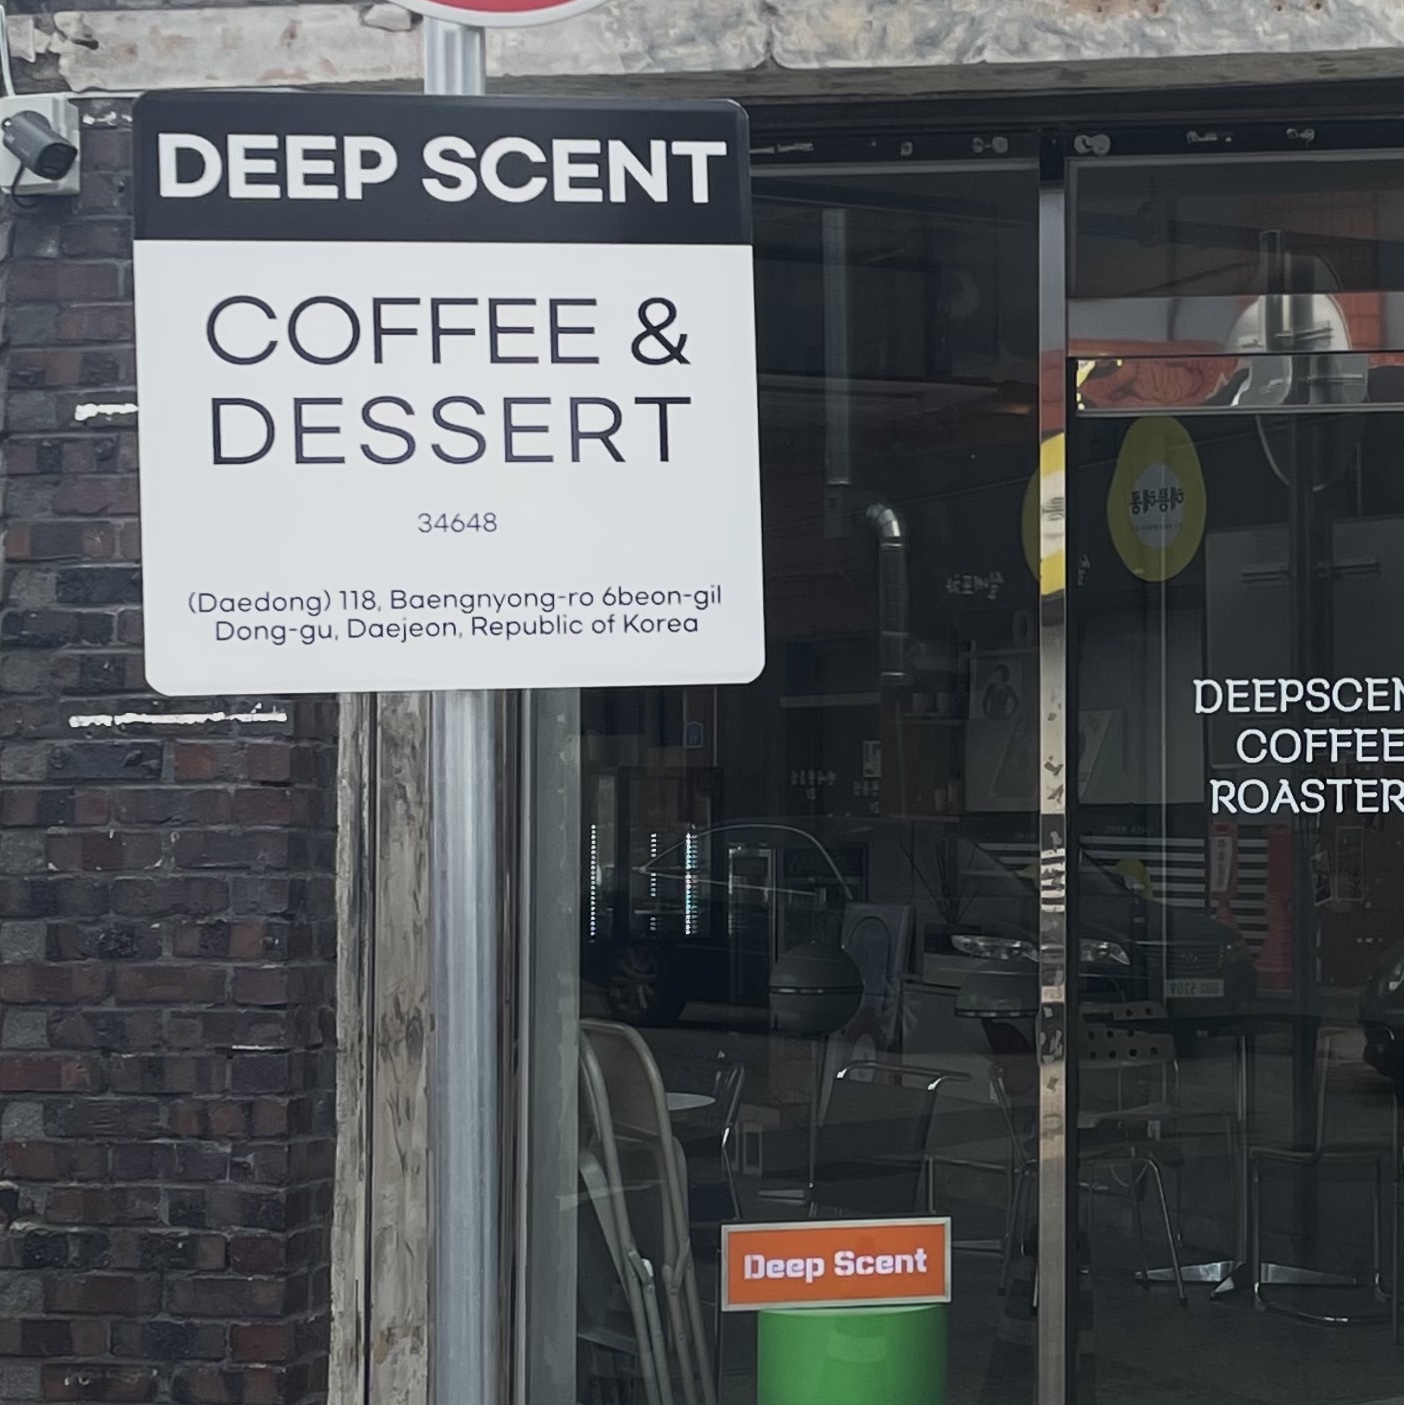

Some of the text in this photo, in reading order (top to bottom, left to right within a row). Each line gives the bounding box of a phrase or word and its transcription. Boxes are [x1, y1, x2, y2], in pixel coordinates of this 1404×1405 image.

[157, 132, 728, 204] DEEP SCENT
[205, 295, 692, 366] COFFEE &
[211, 395, 692, 467] DESSERT
[417, 511, 499, 535] 34648
[188, 584, 722, 617] (Daedong) 118, Baengnyong-ro 6beon-gil
[215, 613, 699, 646] Dong-gu, Daejeon, Republic of Korea
[743, 1247, 928, 1284] Deep Scent
